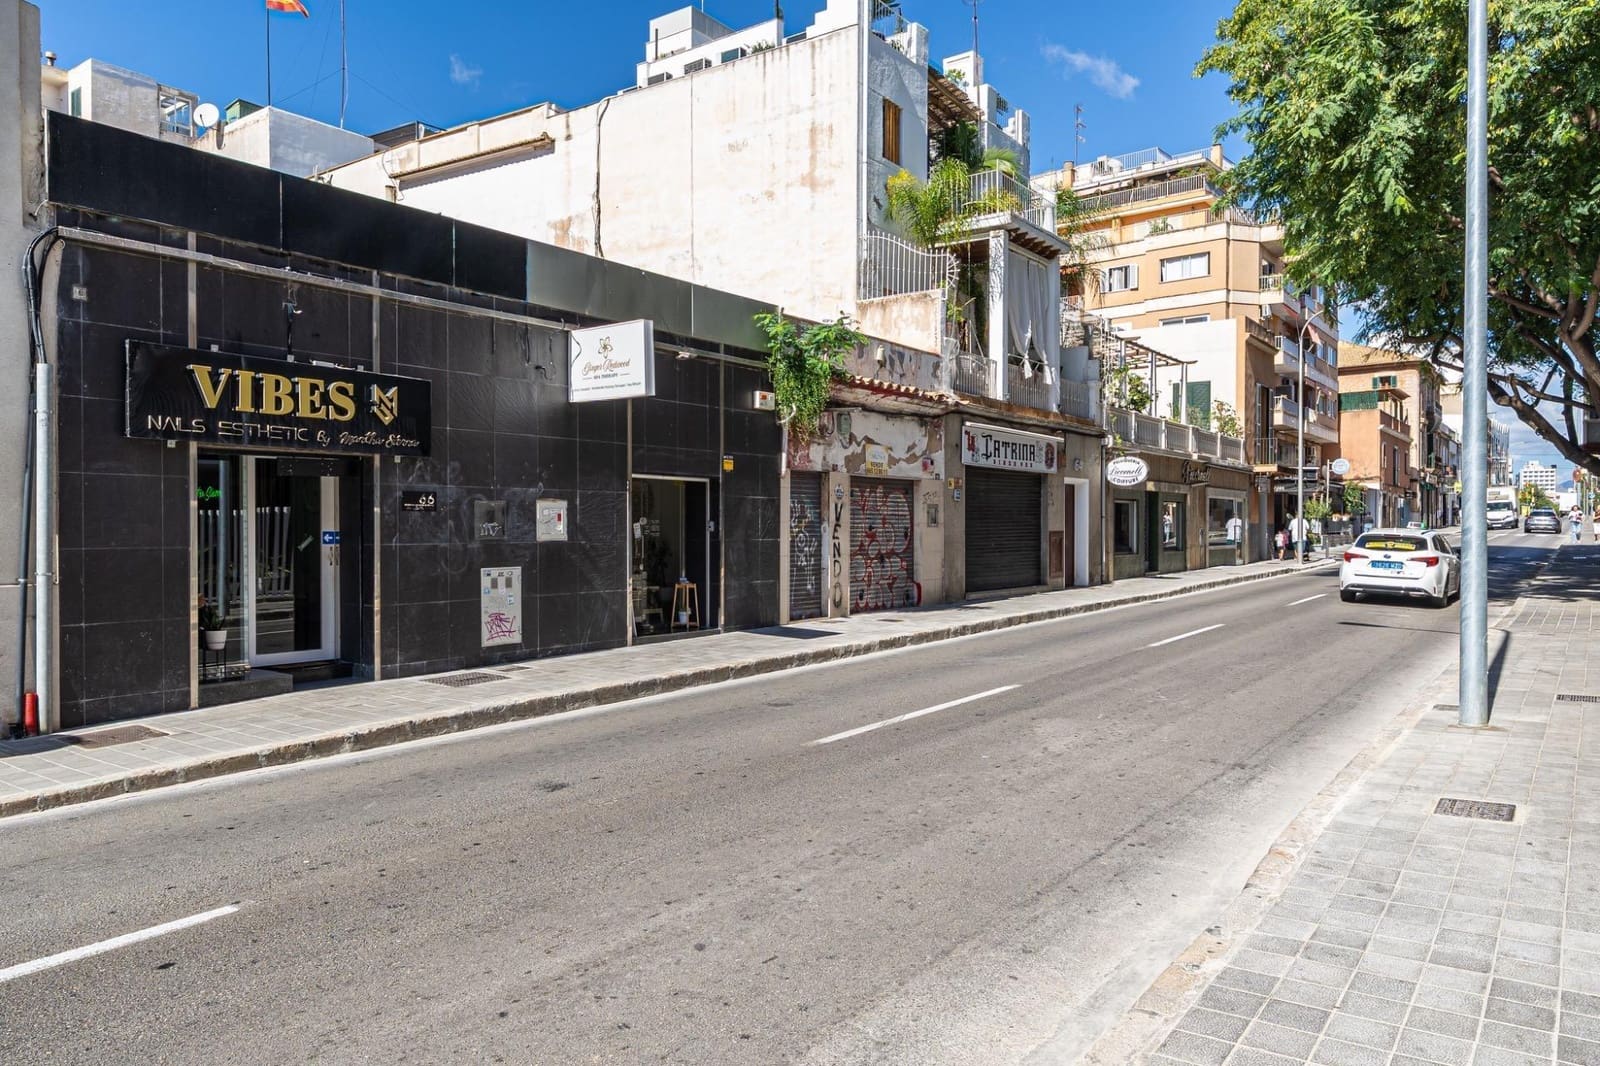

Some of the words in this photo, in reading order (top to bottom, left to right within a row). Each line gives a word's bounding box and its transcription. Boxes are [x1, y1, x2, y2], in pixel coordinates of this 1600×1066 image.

[186, 364, 356, 422] VIBES
[147, 414, 206, 434] NAILS
[218, 421, 309, 442] ESTHETIC
[832, 502, 843, 609] VENDO
